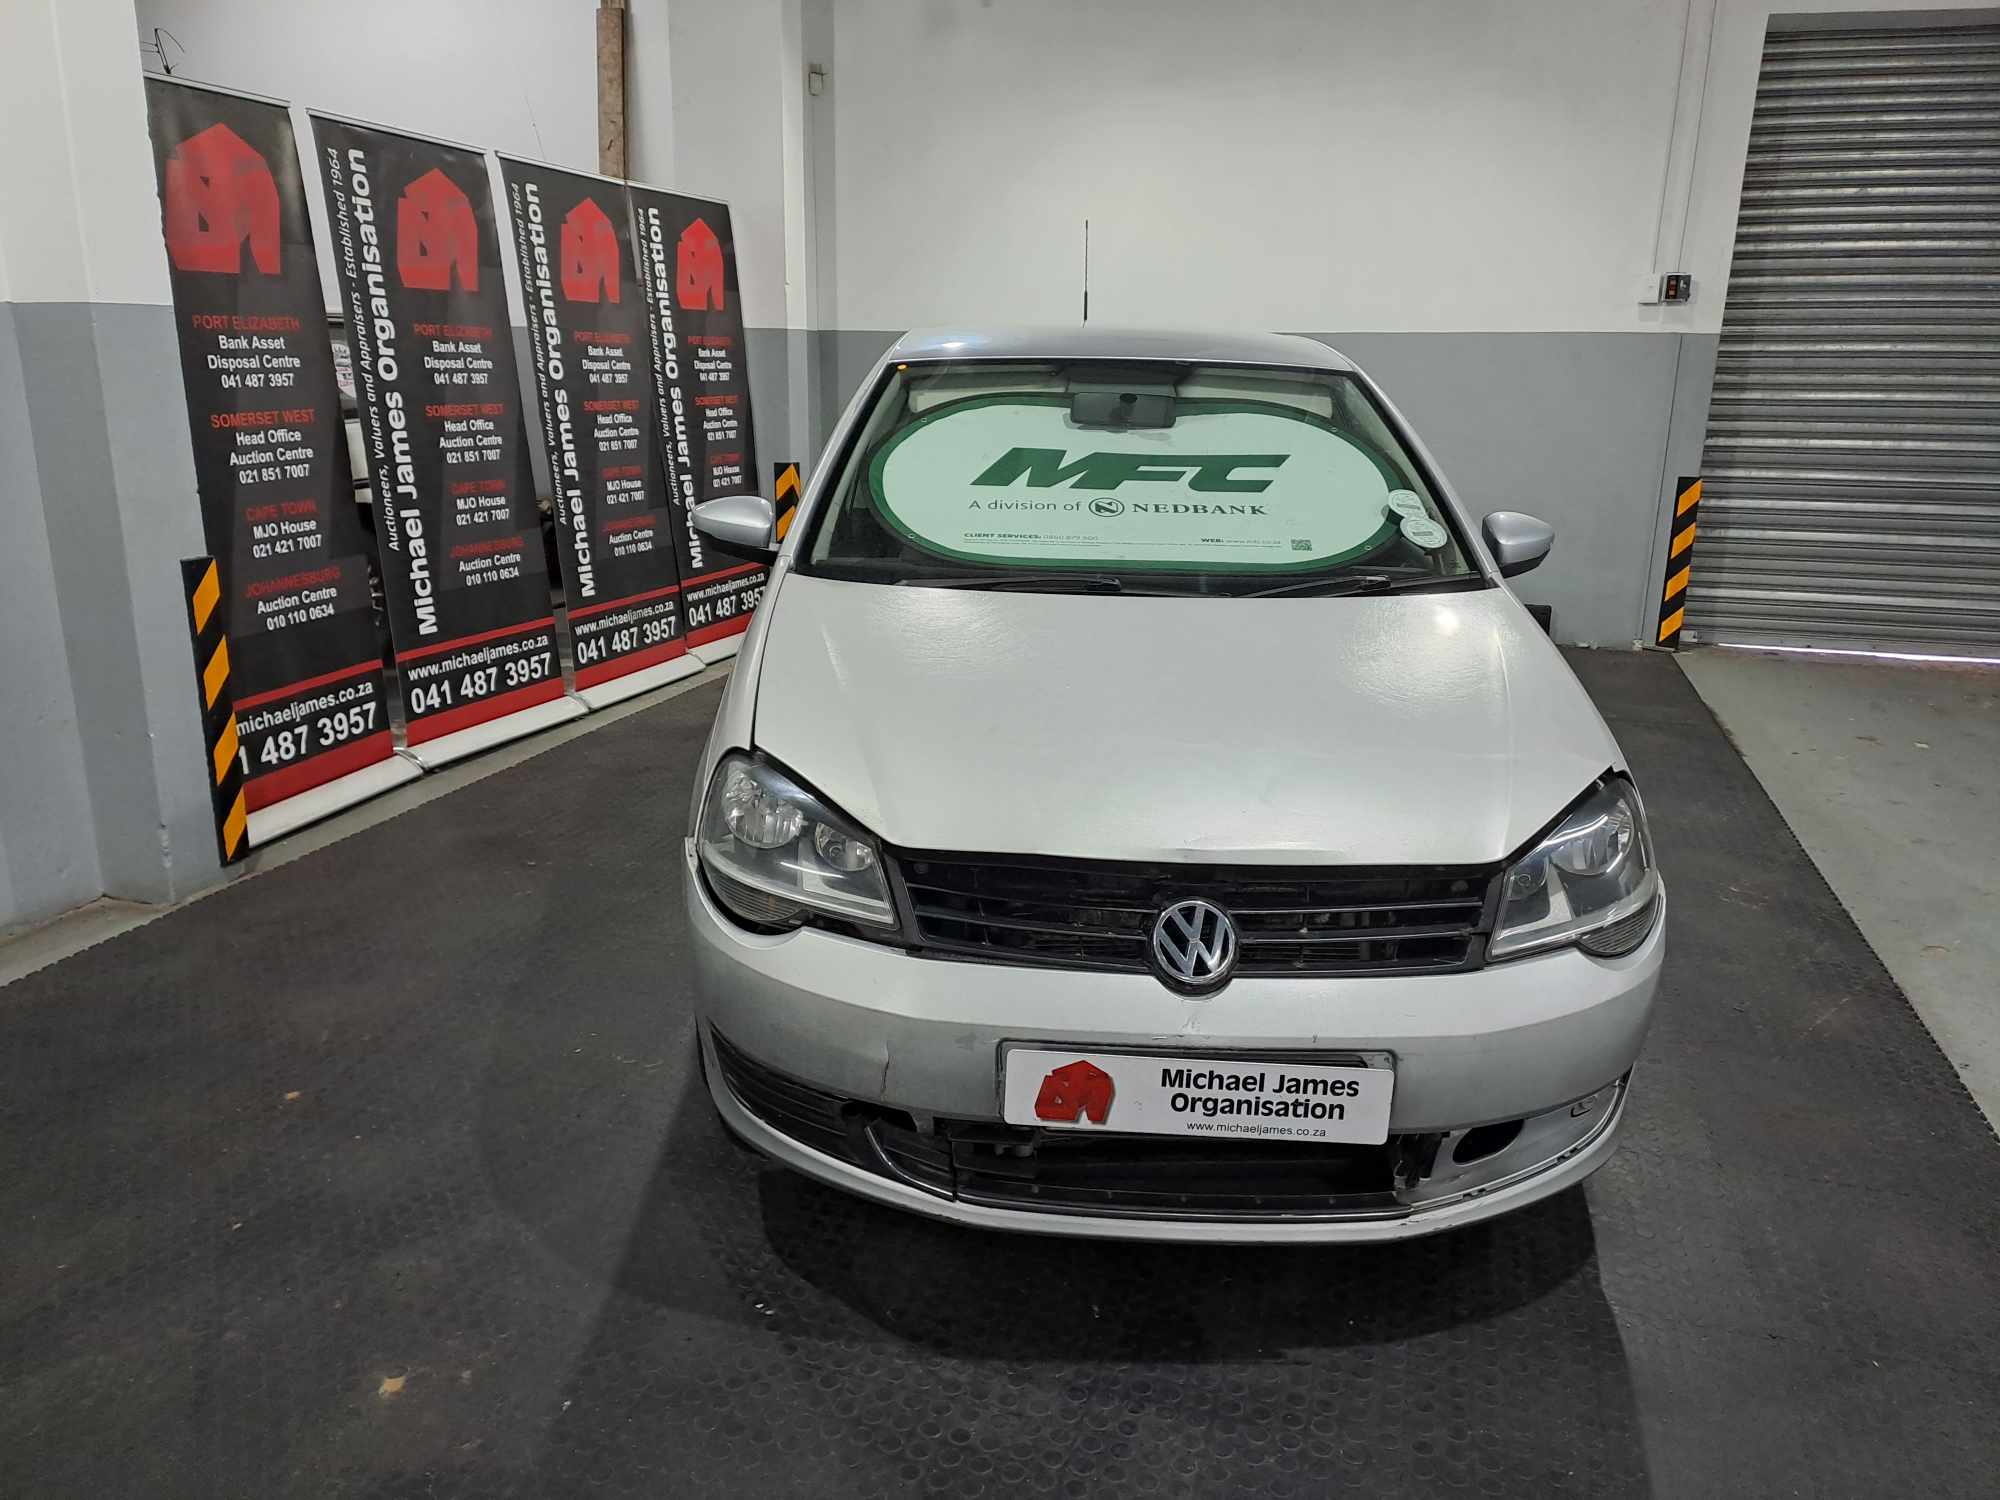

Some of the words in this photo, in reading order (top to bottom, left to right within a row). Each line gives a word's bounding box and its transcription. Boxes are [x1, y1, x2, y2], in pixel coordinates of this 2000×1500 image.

[328, 148, 343, 185] 1964
[333, 189, 357, 278] Established
[348, 149, 399, 381] Organisation
[517, 216, 534, 293] Established
[525, 183, 564, 380] Organisation
[648, 207, 679, 379] Organisation
[192, 315, 228, 329] PORT
[351, 291, 373, 371] Appraisers
[218, 335, 249, 350] Bank
[252, 336, 286, 350] Asset
[432, 340, 456, 353] Bank
[458, 342, 482, 353] Asset
[529, 303, 545, 371] Appraisers
[207, 354, 260, 371] Disposal
[263, 355, 301, 368] Centre
[424, 356, 464, 371] Disposal
[466, 357, 493, 369] Centre
[221, 374, 242, 388] 041
[245, 374, 265, 388] 487
[269, 373, 294, 387] 3957
[361, 373, 377, 401] and
[434, 373, 450, 384] 041
[452, 373, 468, 384] 487
[536, 372, 548, 398] and
[654, 373, 664, 396] and
[210, 411, 279, 428] SOMERSET
[282, 409, 315, 423] WEST
[369, 405, 386, 459] Valuers
[444, 420, 467, 432] Head
[469, 419, 494, 431] Office
[543, 402, 555, 446] Valuers
[670, 387, 690, 467] James
[236, 431, 265, 446] Head
[268, 428, 302, 442] Office
[385, 391, 418, 500] James
[440, 436, 474, 448] Auction
[476, 435, 503, 446] Centre
[554, 389, 579, 482] James
[230, 451, 274, 466] Auction
[277, 447, 314, 461] Centre
[446, 452, 462, 464] 021
[464, 451, 480, 462] 851
[482, 449, 501, 461] 7007
[969, 447, 1291, 493] MFC
[239, 470, 259, 484] 021
[262, 467, 282, 481] 851
[284, 464, 310, 479] 7007
[550, 451, 567, 525] Auctioneers,
[621, 479, 642, 490] House
[376, 464, 400, 551] Auctioneers,
[456, 498, 476, 510] MJO
[478, 496, 506, 507] House
[968, 499, 981, 510] A
[987, 500, 1057, 511] division
[1063, 501, 1082, 512] of
[1132, 503, 1268, 515] NEDBANK
[253, 524, 278, 539] MJO
[280, 520, 317, 535] House
[456, 514, 471, 526] 021
[473, 512, 489, 523] 421
[491, 509, 510, 521] 7007
[253, 544, 272, 558] 021
[274, 539, 294, 553] 421
[297, 534, 322, 550] 7007
[566, 489, 596, 598] Michael
[400, 508, 438, 636] Michael
[459, 559, 492, 572] Auction
[494, 553, 521, 566] Centre
[466, 574, 481, 586] 010
[483, 570, 498, 582] 110
[500, 567, 520, 579] 0634
[257, 595, 299, 614] Auction
[302, 587, 337, 603] Centre
[686, 573, 765, 602] www.michaeljames.co.za
[267, 616, 286, 631] 010
[288, 609, 307, 625] 110
[309, 603, 335, 619] 0634
[574, 600, 674, 637] www.michaeljames.co.za
[689, 603, 712, 626] 041
[716, 595, 736, 618] 487
[577, 636, 607, 665] 041
[612, 626, 638, 652] 487
[643, 616, 676, 644] 3957
[407, 635, 549, 681] www.michaeljames.co.za
[410, 679, 452, 714] 041
[460, 667, 498, 698] 487
[504, 652, 551, 687] 3957
[236, 681, 373, 736] michaeljames.co.za
[260, 724, 309, 765] 487
[317, 701, 377, 746] 3957
[1161, 1068, 1265, 1093] Michael
[1272, 1074, 1360, 1097] James
[1170, 1092, 1345, 1120] Organisation
[1187, 1121, 1326, 1137] www.michaeljames.co.za
